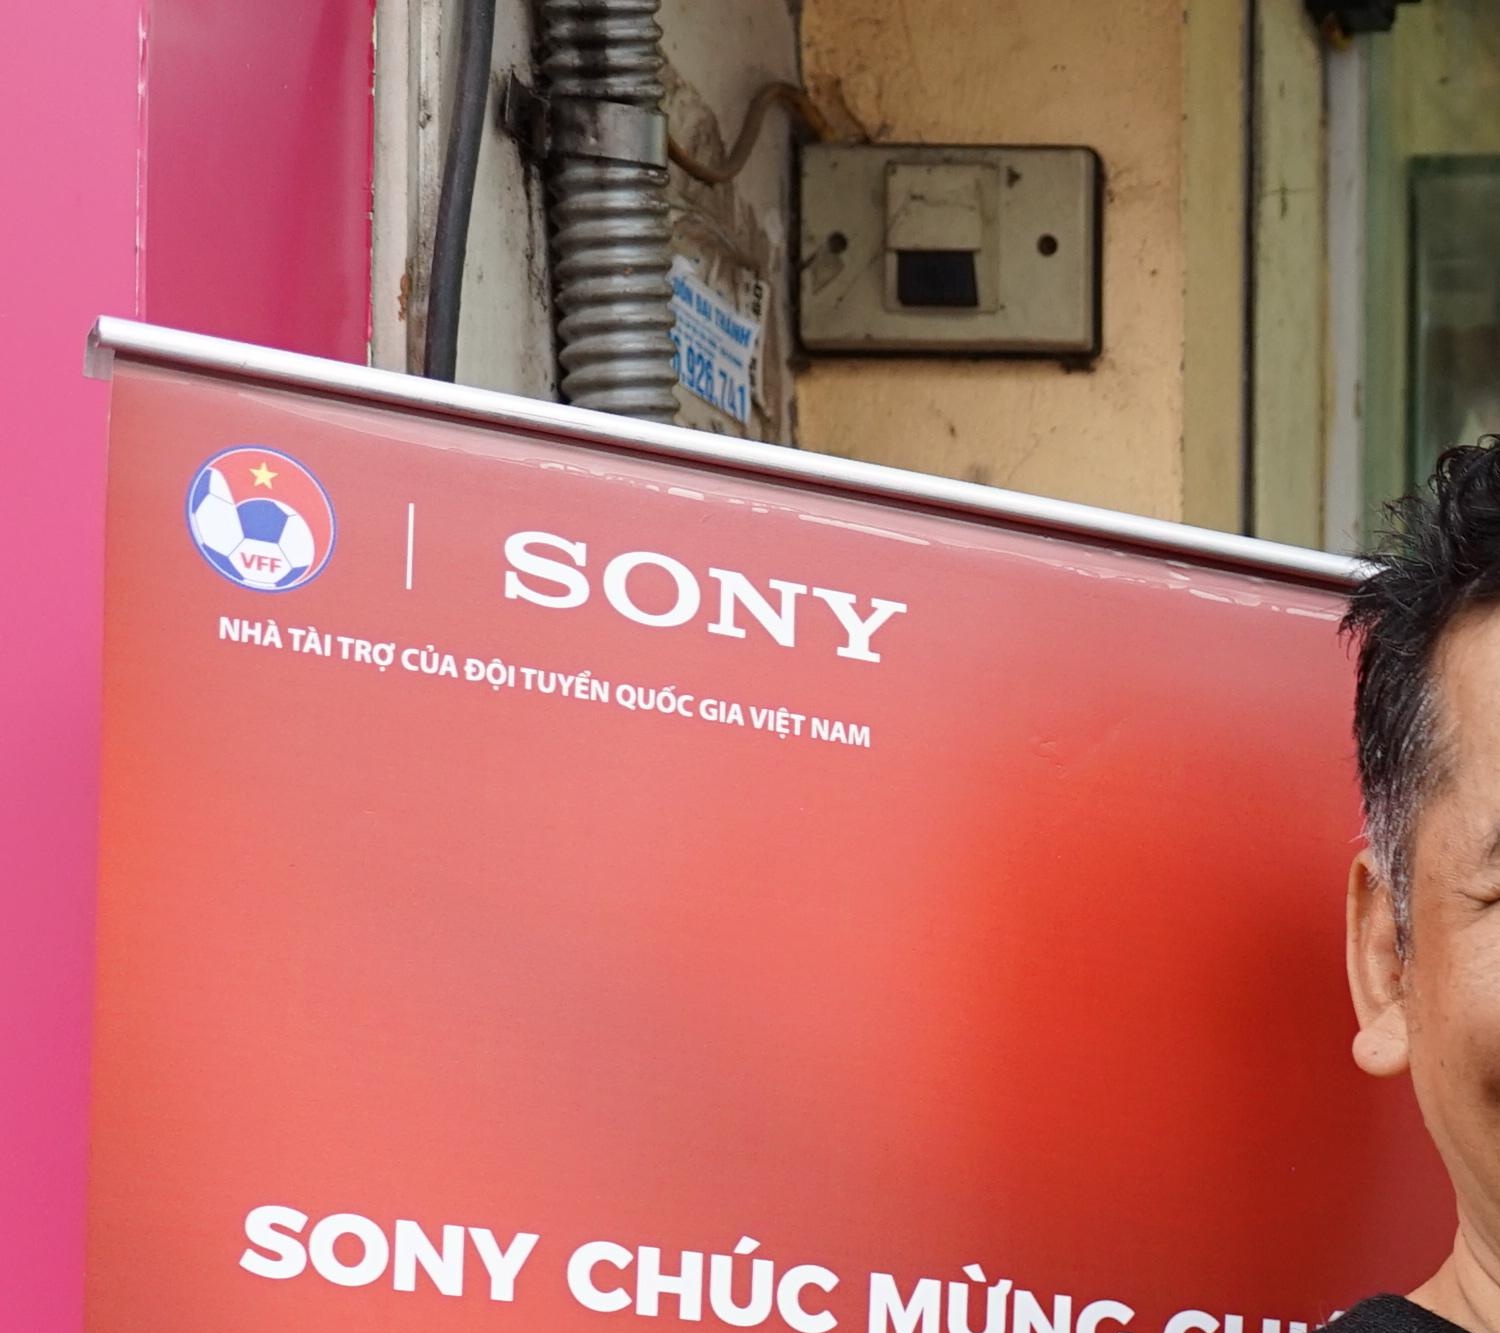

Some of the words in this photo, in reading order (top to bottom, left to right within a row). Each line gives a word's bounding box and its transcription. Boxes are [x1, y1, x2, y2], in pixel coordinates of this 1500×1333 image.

[240, 552, 282, 573] VFF
[504, 530, 907, 664] SONY
[220, 617, 282, 649] NHÀ
[287, 627, 332, 657] TÀI
[337, 637, 396, 672] TRỢ
[401, 645, 458, 678] CỦA
[463, 659, 516, 692] ĐỘI
[520, 668, 610, 703] TUYỂN
[615, 685, 694, 717] QUỐC
[699, 699, 745, 726] GIA
[749, 707, 806, 740] VIỆT
[811, 718, 870, 748] NAM
[240, 1206, 539, 1301] SONY
[567, 1236, 839, 1333] CHÚC
